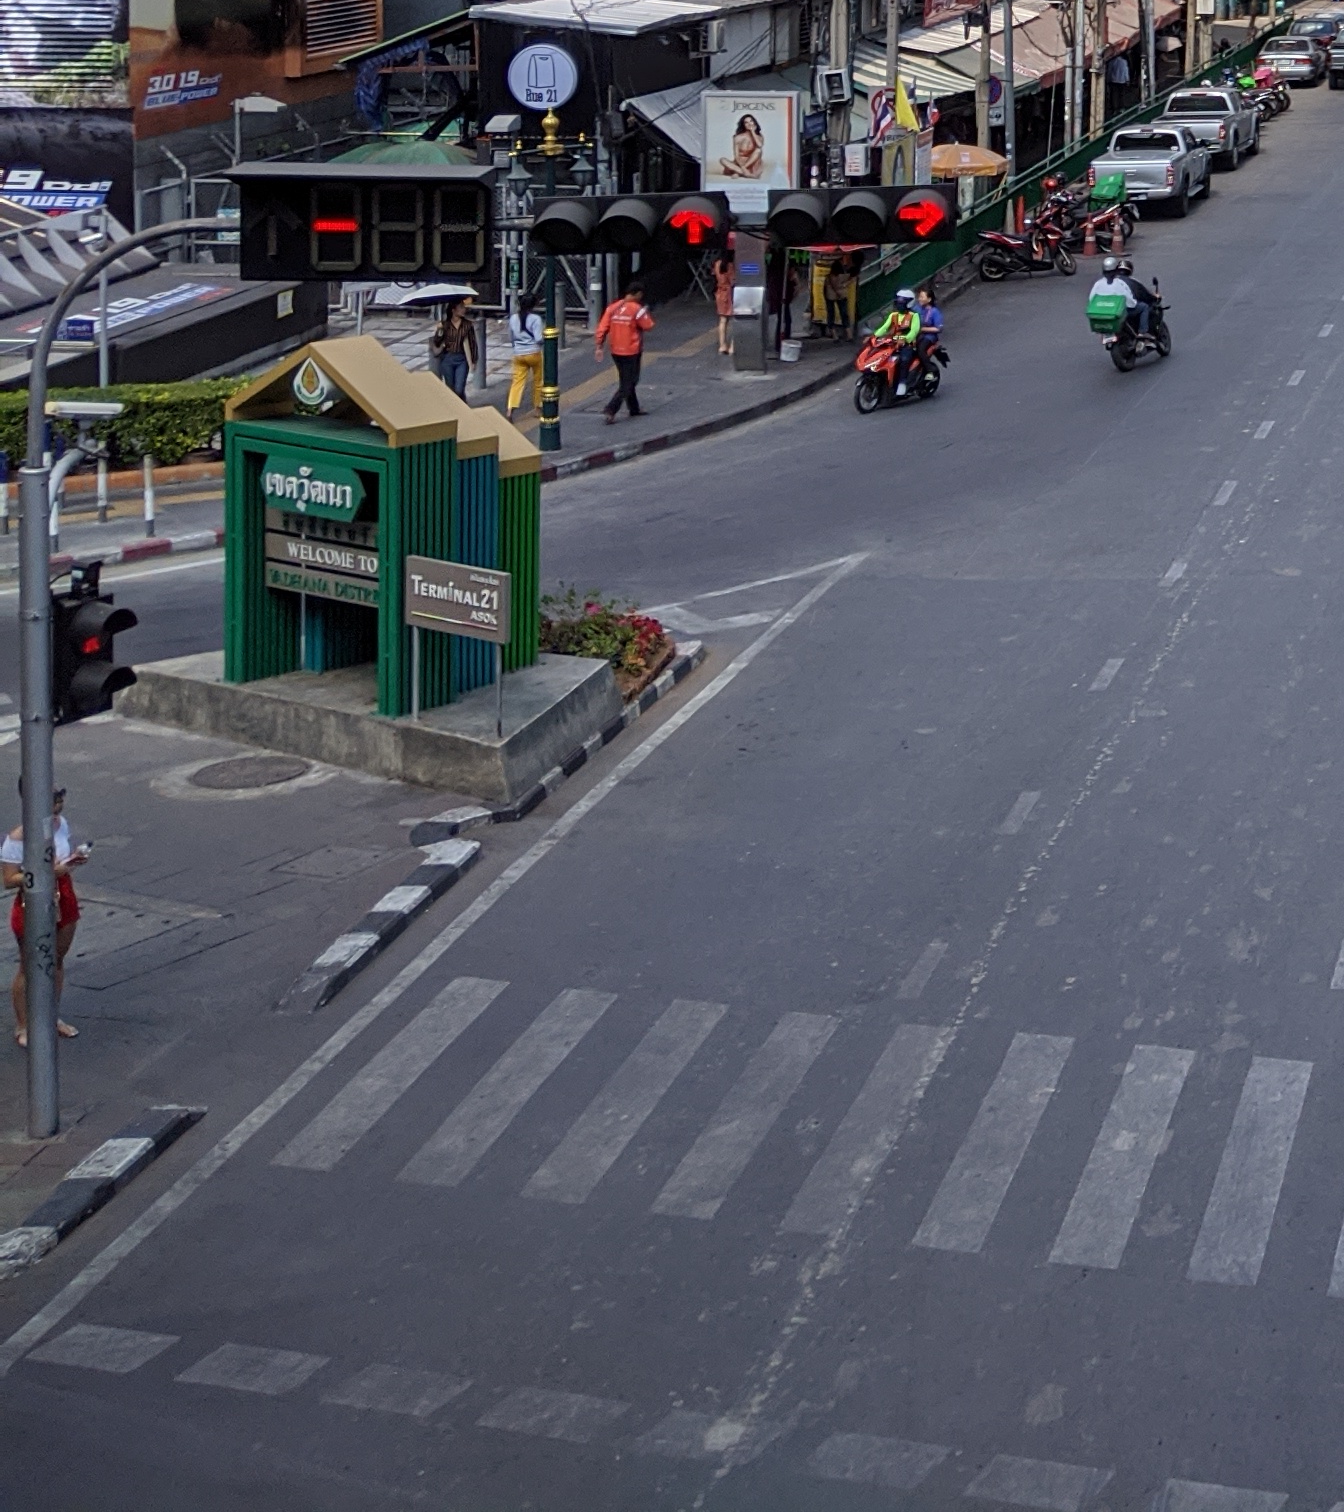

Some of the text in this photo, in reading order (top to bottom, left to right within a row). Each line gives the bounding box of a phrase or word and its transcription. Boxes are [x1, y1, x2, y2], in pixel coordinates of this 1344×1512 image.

[546, 89, 558, 103] 21
[0, 194, 100, 207] OWER
[265, 465, 354, 512] เขตวัฒนา
[287, 541, 379, 573] WELCOME TO
[470, 611, 498, 625] ASOK
[23, 872, 35, 889] 3
